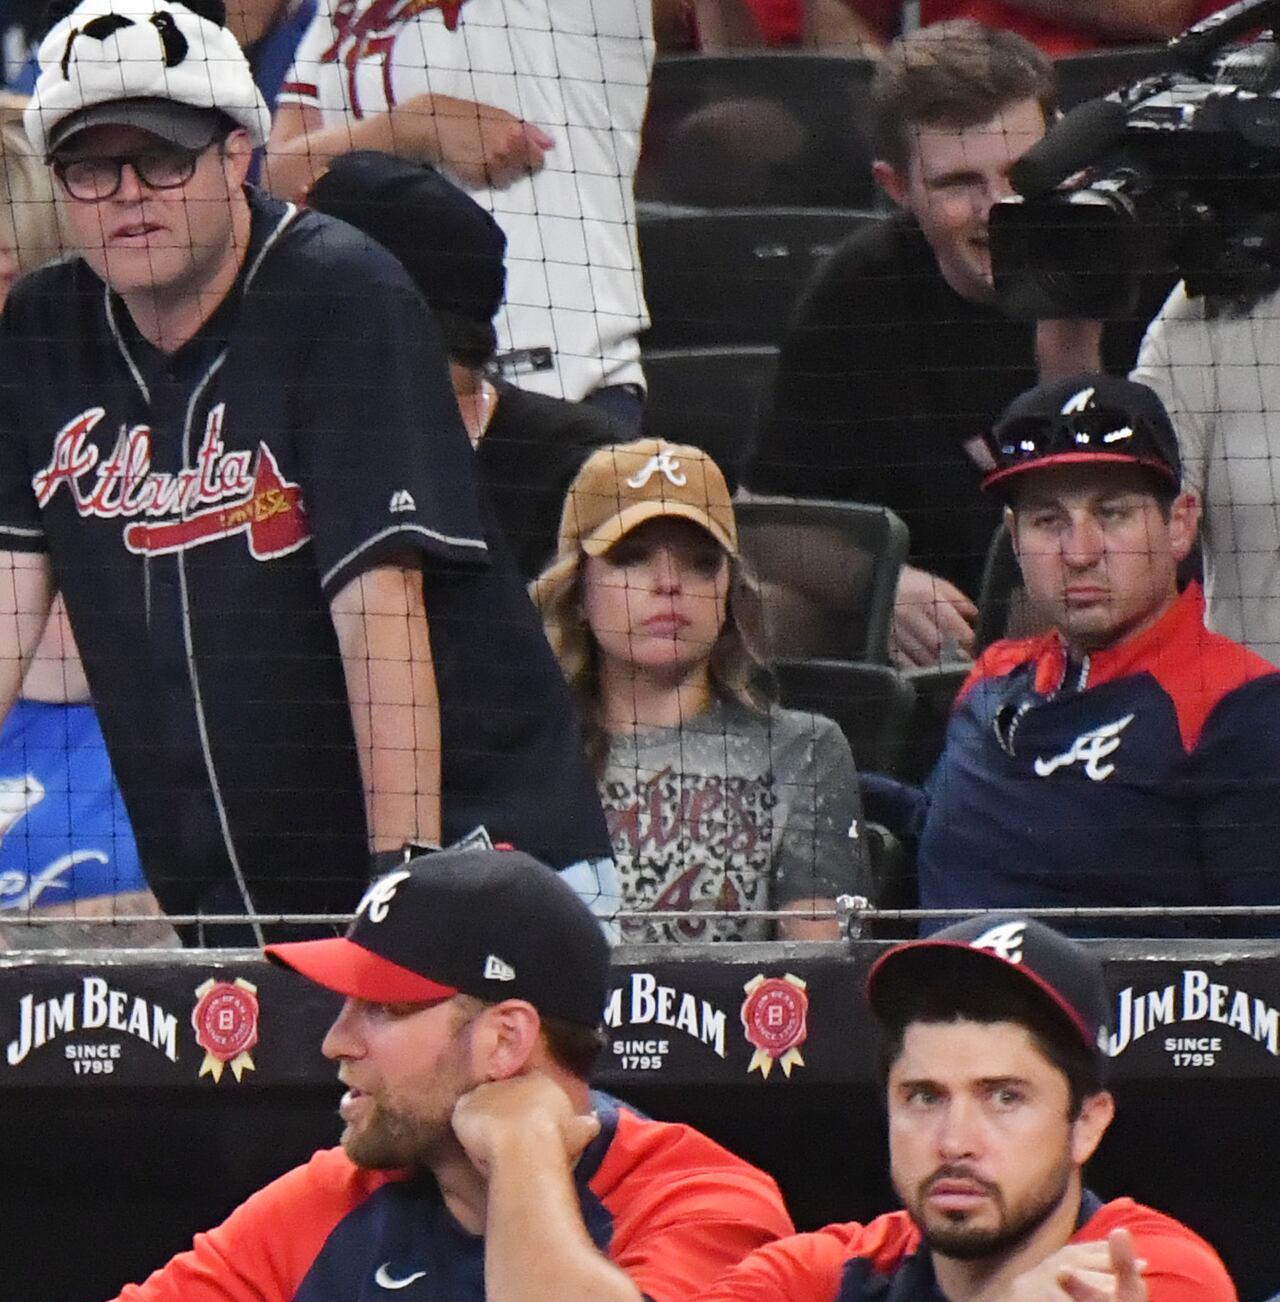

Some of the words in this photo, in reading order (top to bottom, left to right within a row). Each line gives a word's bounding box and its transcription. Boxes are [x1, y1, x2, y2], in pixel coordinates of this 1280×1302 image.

[32, 402, 255, 518] Atlanta
[627, 450, 687, 489] A
[1035, 713, 1135, 781] A
[355, 871, 411, 923] A
[7, 993, 75, 1066] JIM
[82, 976, 178, 1063] BEAM
[218, 1009, 233, 1030] B
[629, 973, 727, 1059] BEAM
[768, 1005, 783, 1026] B
[1109, 986, 1177, 1057] JIM
[1181, 970, 1280, 1056] BEAM
[65, 1044, 121, 1059] SINCE
[613, 1040, 670, 1055] SINCE
[1164, 1037, 1223, 1052] SINCE
[73, 1060, 114, 1075] 1795
[622, 1056, 662, 1071] 1795
[1173, 1053, 1216, 1067] 1795
